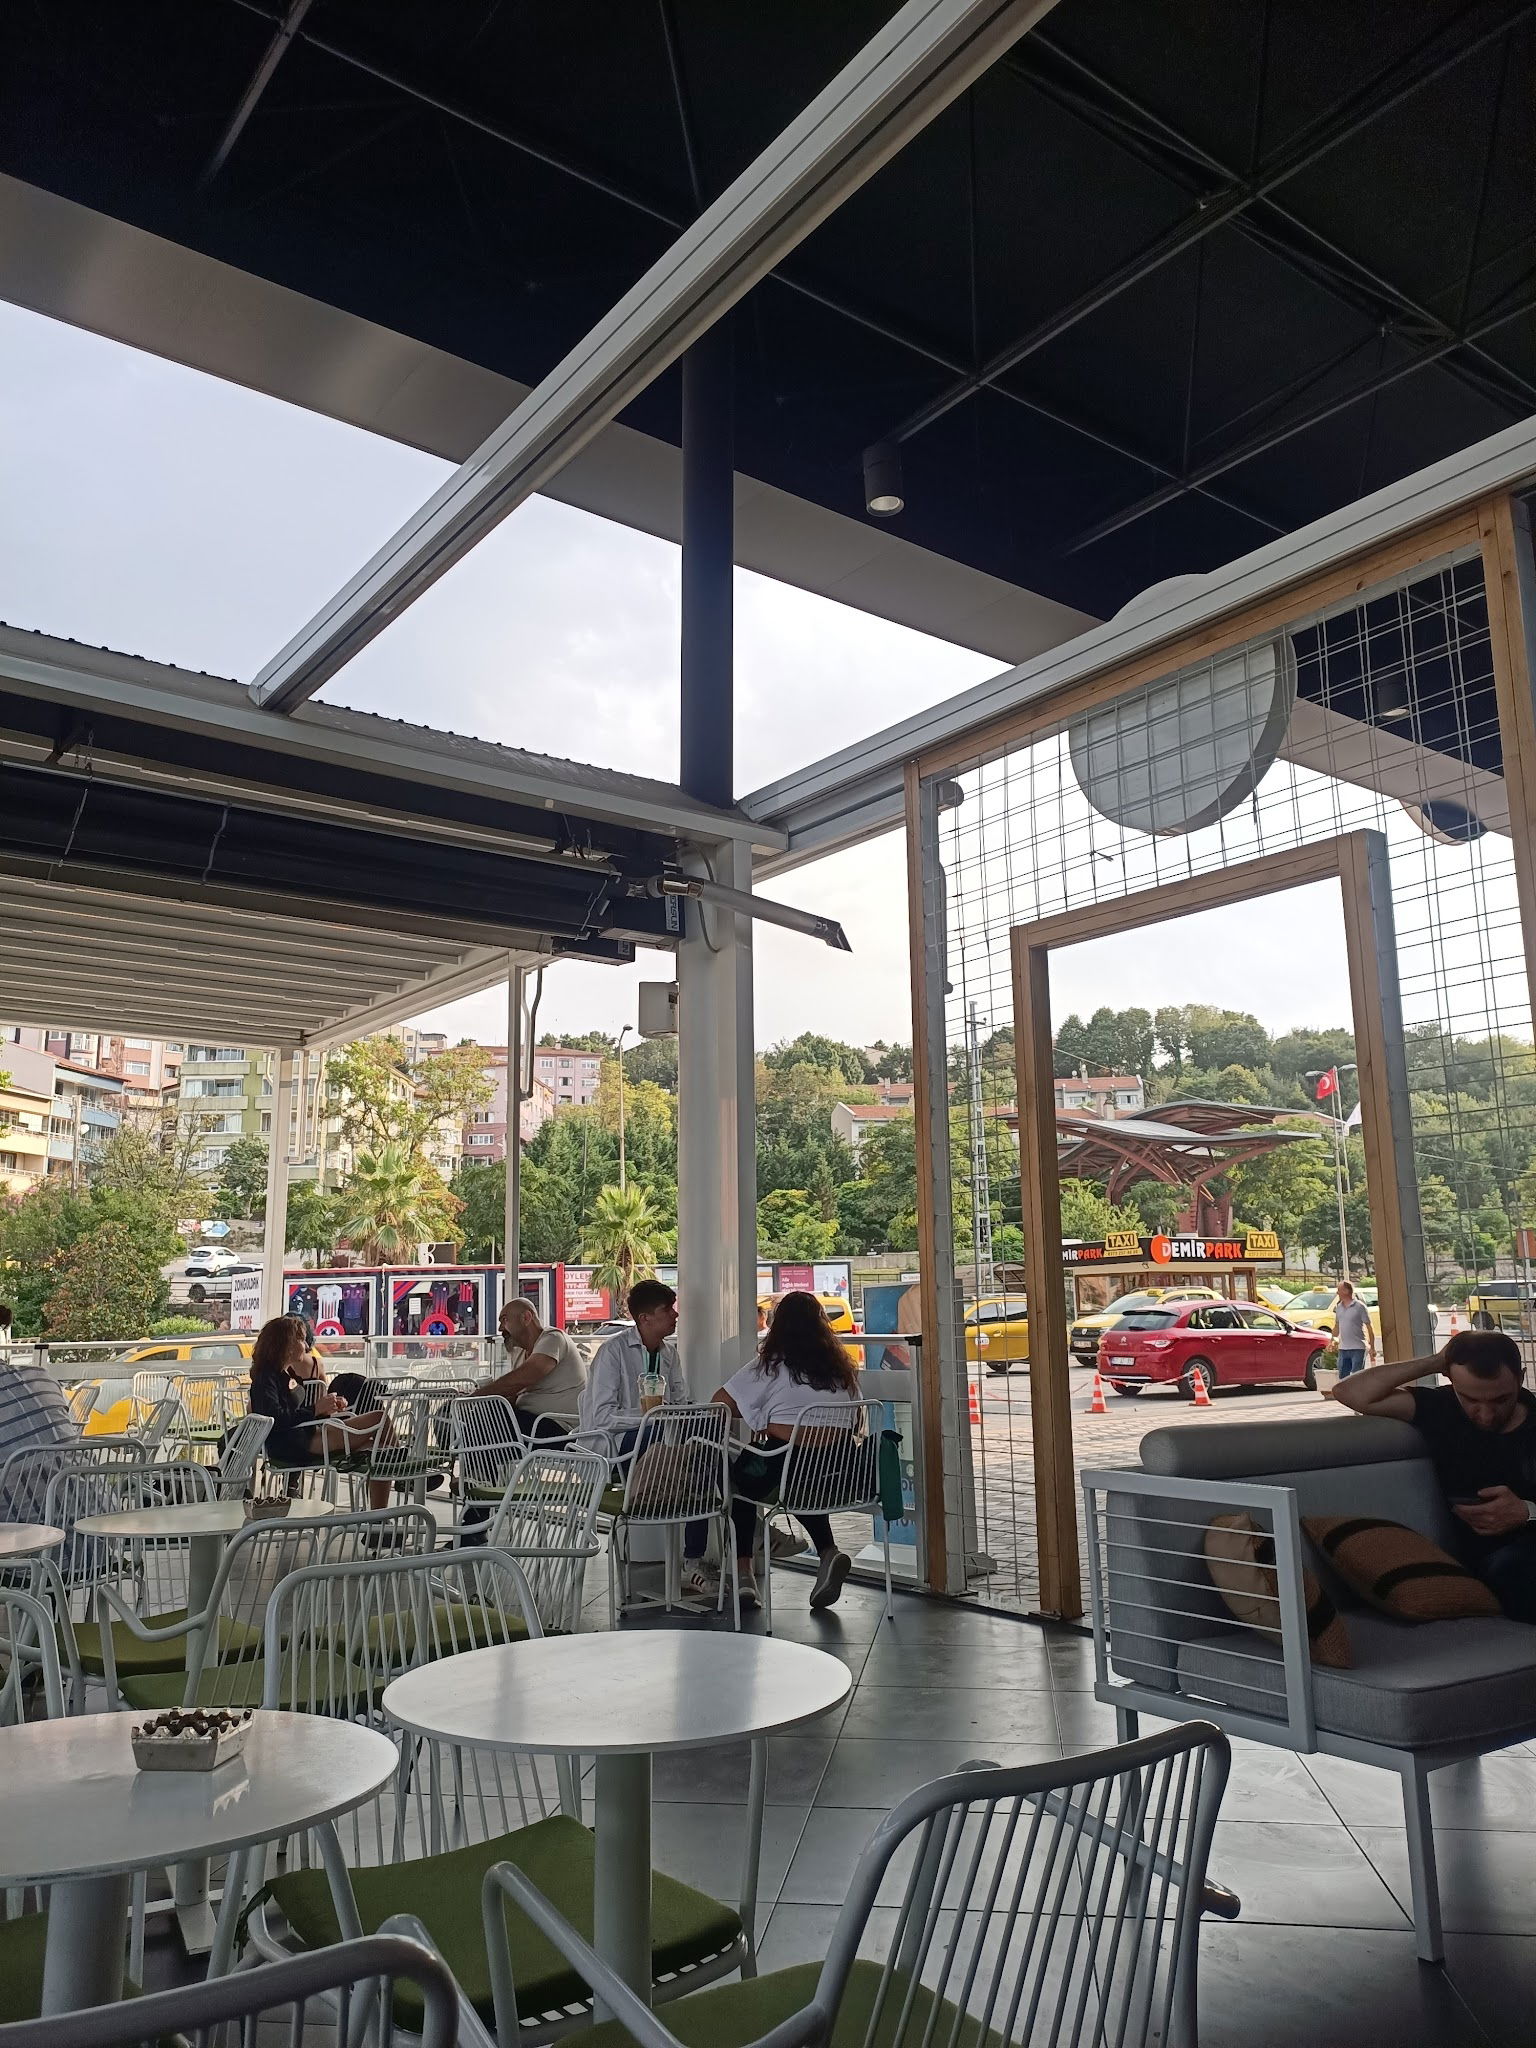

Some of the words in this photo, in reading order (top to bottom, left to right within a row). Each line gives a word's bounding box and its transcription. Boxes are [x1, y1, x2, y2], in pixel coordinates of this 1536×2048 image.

[1109, 1234, 1134, 1247] TAXI
[1251, 1235, 1275, 1248] TAXI
[1062, 1247, 1103, 1261] MİRPARK
[234, 1277, 259, 1291] ZONGULDAK
[248, 1297, 260, 1310] SPOR
